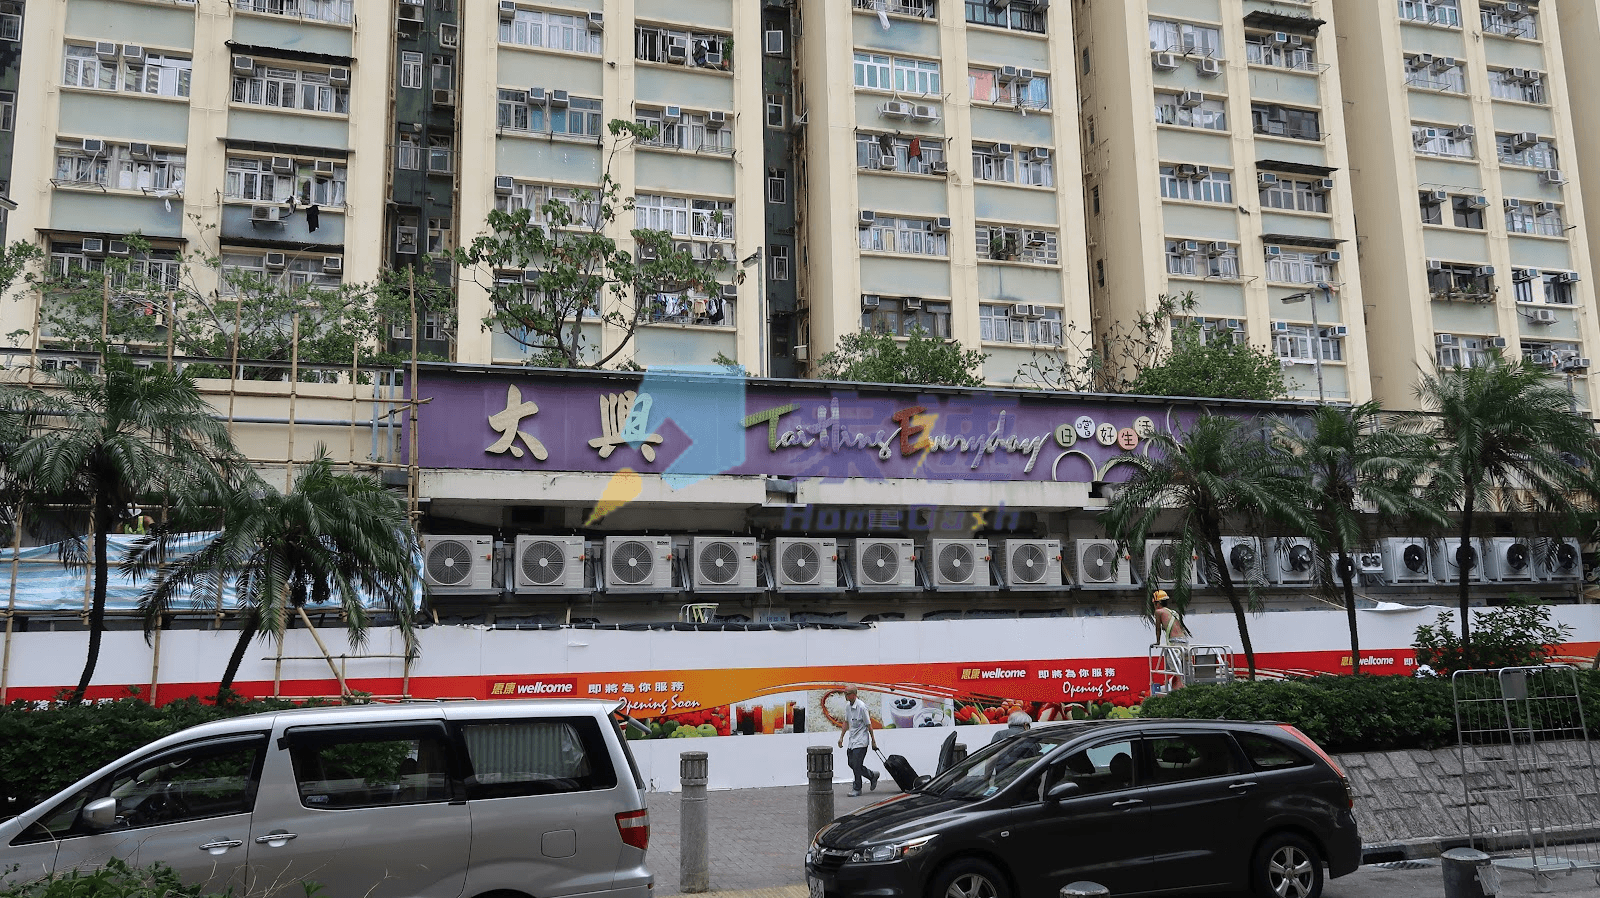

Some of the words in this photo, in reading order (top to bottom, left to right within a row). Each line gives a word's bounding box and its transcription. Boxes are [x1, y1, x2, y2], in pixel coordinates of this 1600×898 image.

[485, 383, 664, 462] 太興
[892, 405, 1051, 474] Everyday
[1358, 655, 1394, 666] wellcome
[981, 667, 1026, 679] wellcome
[1038, 667, 1116, 680] 即將為你服務
[491, 682, 516, 695] 惠康
[517, 681, 573, 694] wellcome
[588, 681, 685, 695] 即將為你服務
[1062, 681, 1104, 698] Opening
[1105, 680, 1130, 693] Soon
[671, 693, 701, 710] Soon
